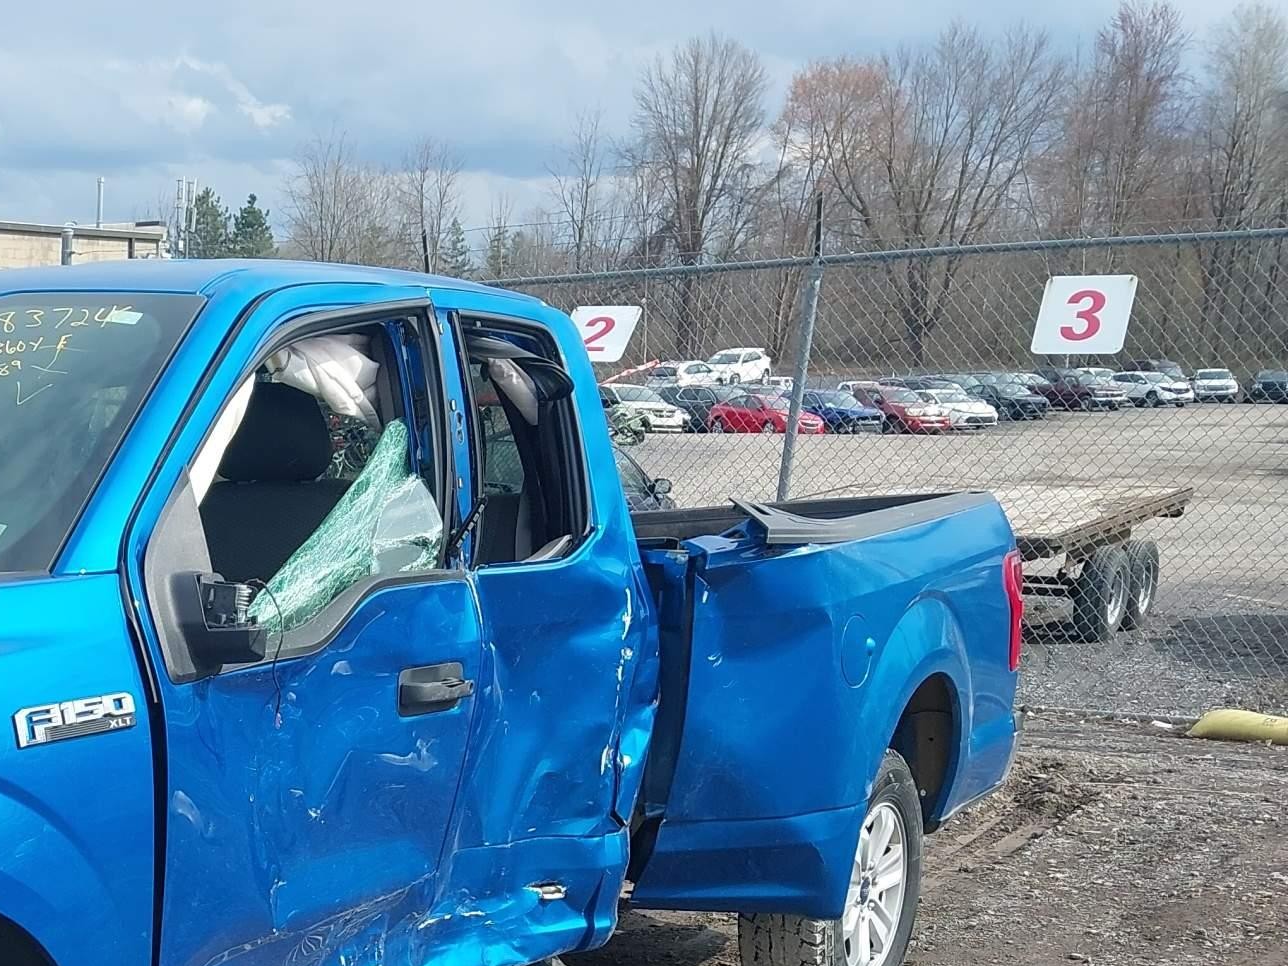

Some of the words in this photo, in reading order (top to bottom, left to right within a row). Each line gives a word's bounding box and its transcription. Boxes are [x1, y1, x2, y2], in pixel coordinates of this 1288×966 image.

[1060, 290, 1106, 341] 3
[583, 316, 616, 351] 2
[109, 716, 133, 729] XLT
